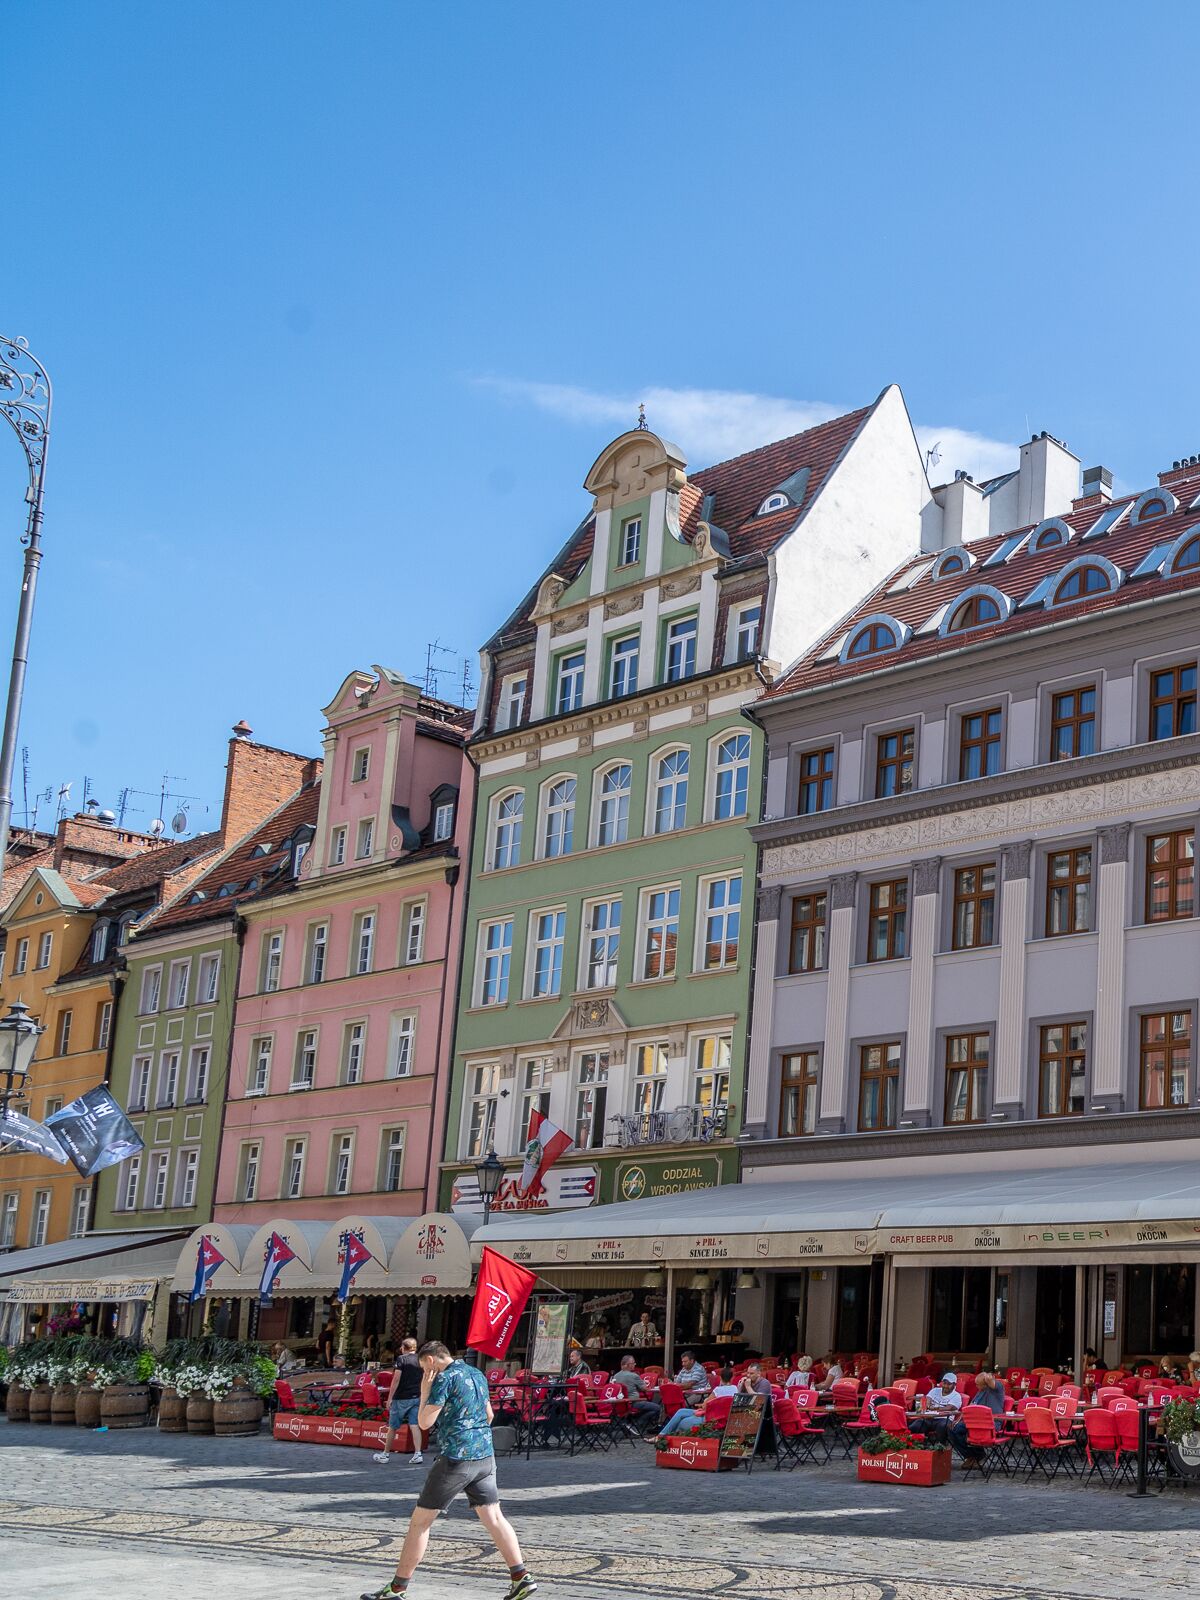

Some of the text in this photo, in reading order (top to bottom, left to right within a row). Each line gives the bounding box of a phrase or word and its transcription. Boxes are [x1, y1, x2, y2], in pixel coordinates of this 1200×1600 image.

[663, 1168, 703, 1180] ODDZIAŁ
[890, 1235, 954, 1244] CRAFT BEER PUB
[1136, 1231, 1168, 1241] OKOCIM
[702, 1238, 716, 1246] PRL
[974, 1238, 1000, 1246] OKOCIM
[690, 1248, 728, 1257] SINCE 1945
[800, 1245, 823, 1254] OKOCIM
[611, 1251, 625, 1259] 1945
[496, 1326, 508, 1348] POLISH
[861, 1459, 918, 1470] POLISH PRL PUB
